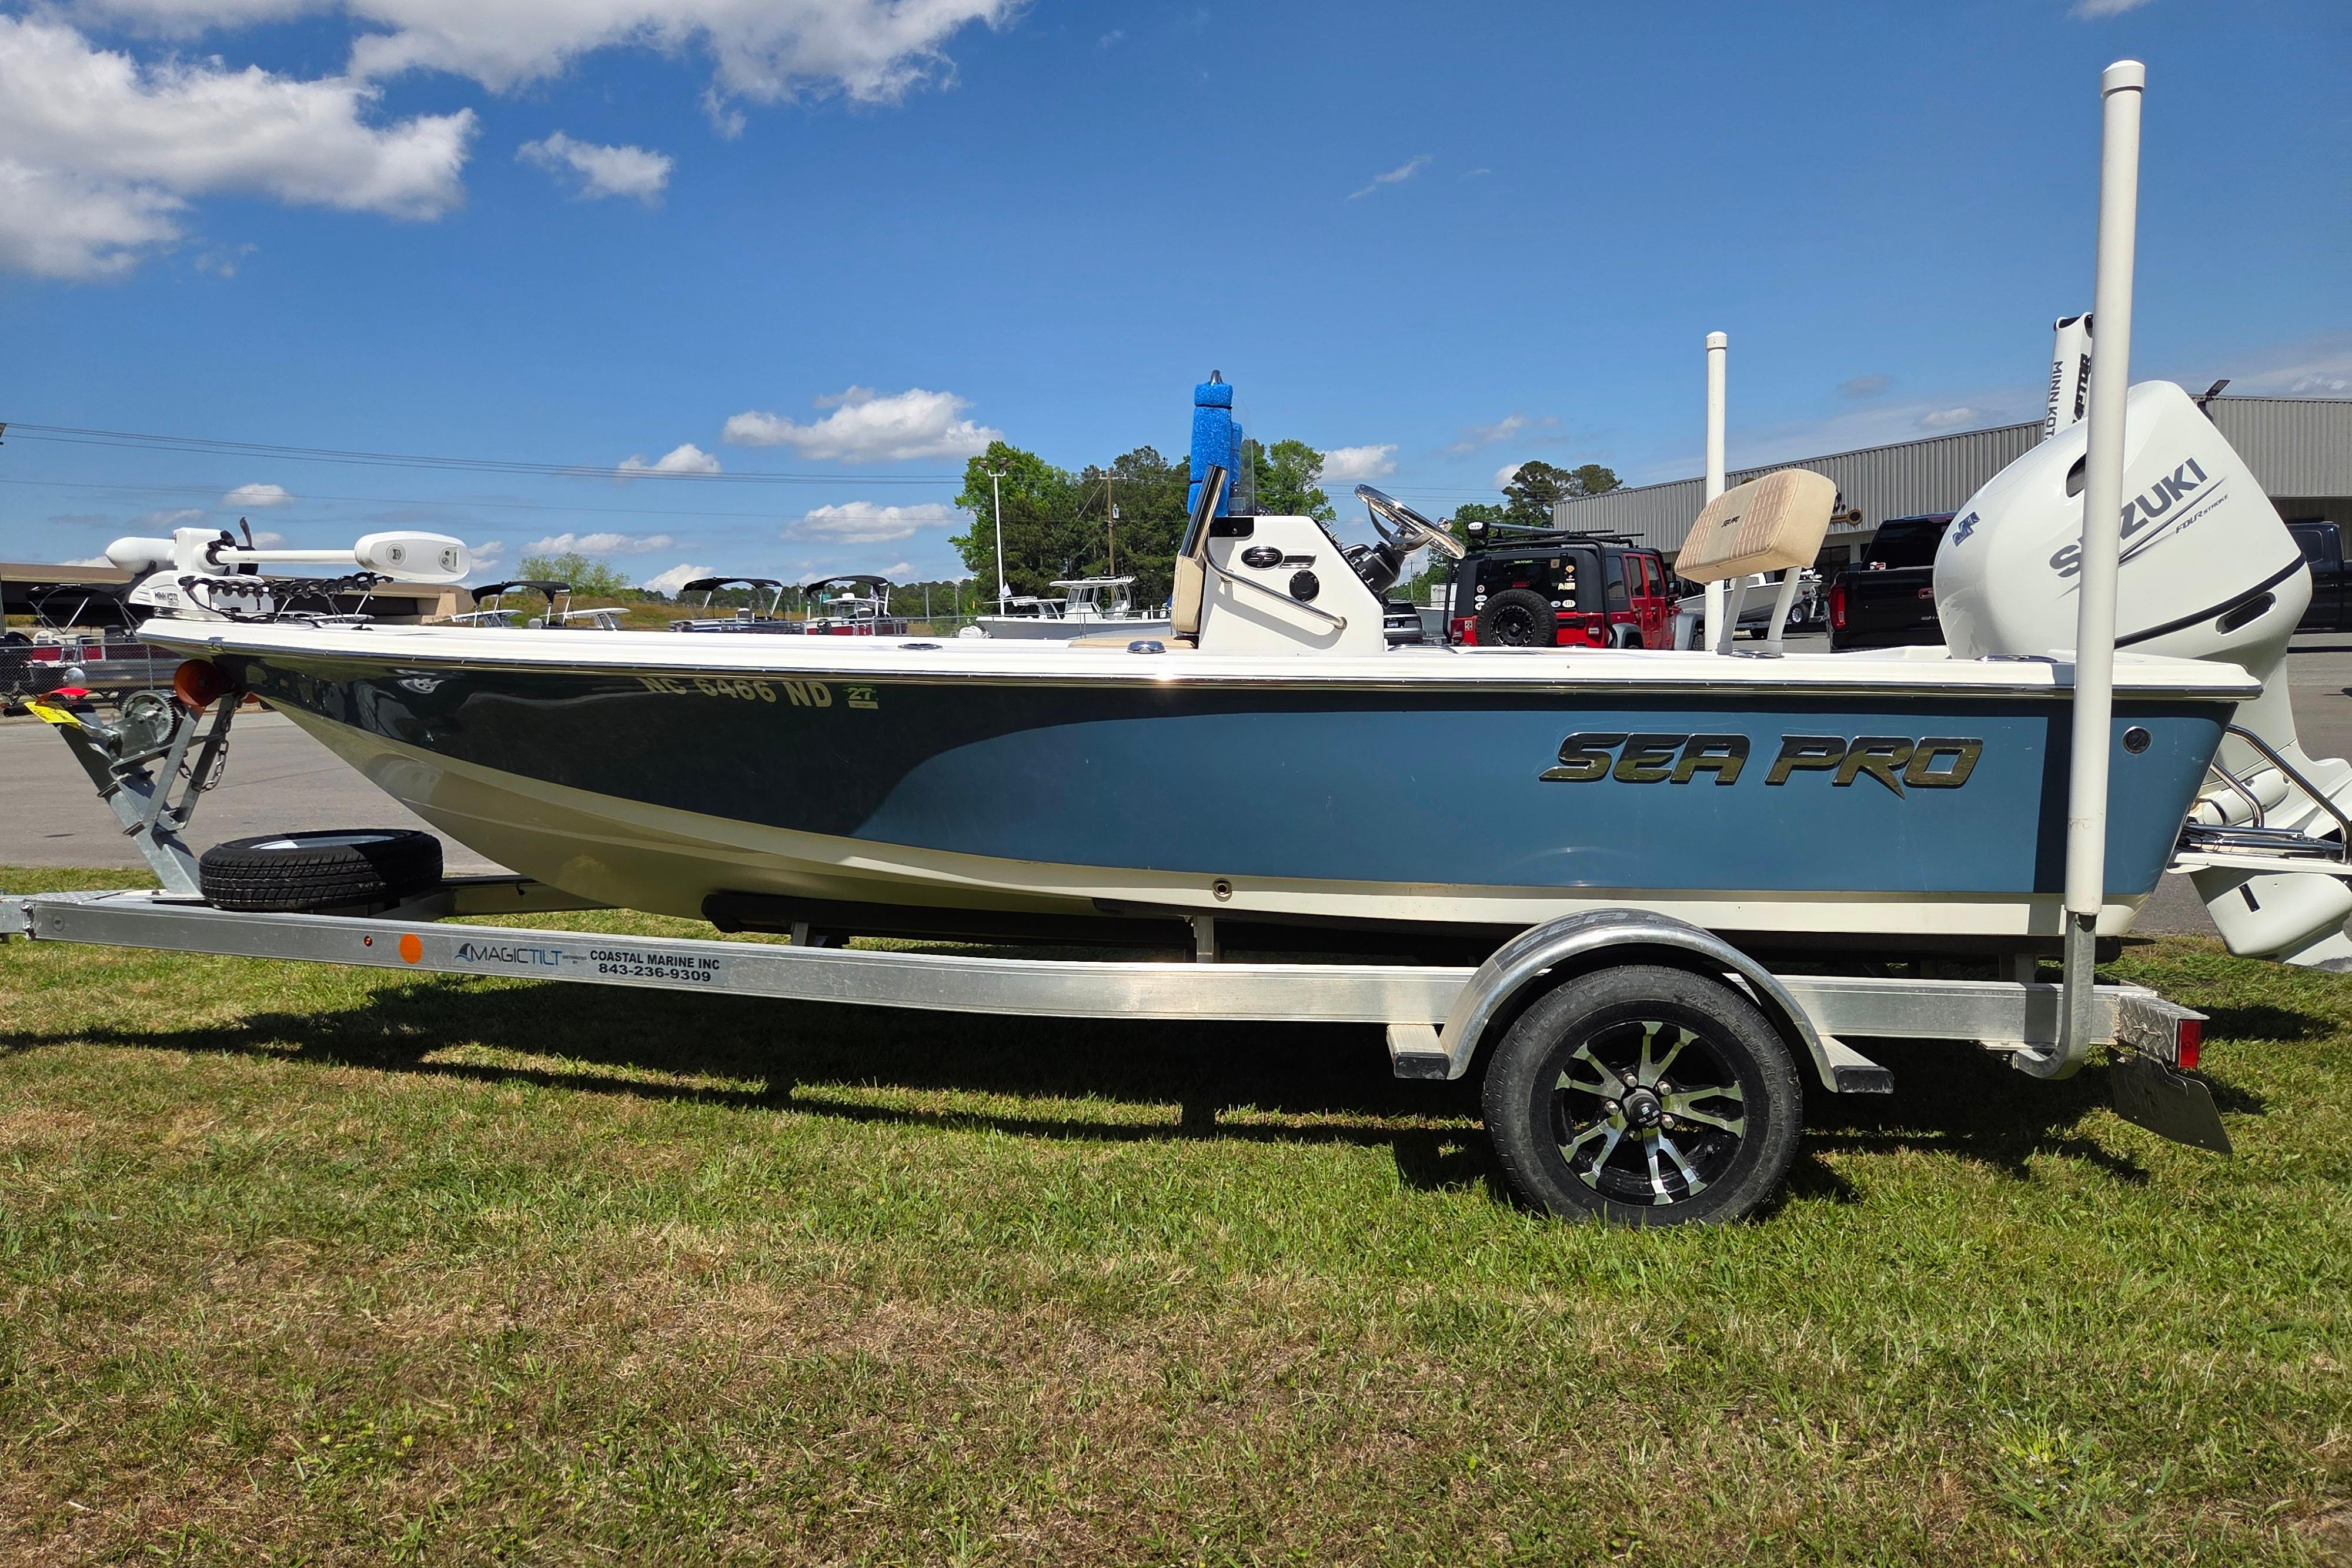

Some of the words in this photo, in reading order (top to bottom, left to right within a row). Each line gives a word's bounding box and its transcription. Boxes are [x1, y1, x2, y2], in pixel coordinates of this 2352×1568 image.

[2049, 360, 2063, 403] MINN
[2072, 353, 2092, 424] APTOR
[2044, 406, 2057, 440] KOT
[2049, 457, 2209, 579] SZUKI
[636, 677, 687, 695] NC
[693, 677, 777, 703] 6466
[782, 681, 833, 707] ND
[847, 687, 873, 700] 27
[1538, 733, 1751, 786] SEA
[1764, 735, 1983, 800] PRO
[470, 945, 563, 967] MAGICTILT
[590, 950, 644, 964] COASTAL
[647, 954, 694, 969] MARINE
[698, 958, 721, 970] INC
[598, 962, 712, 982] 843-236-9309
